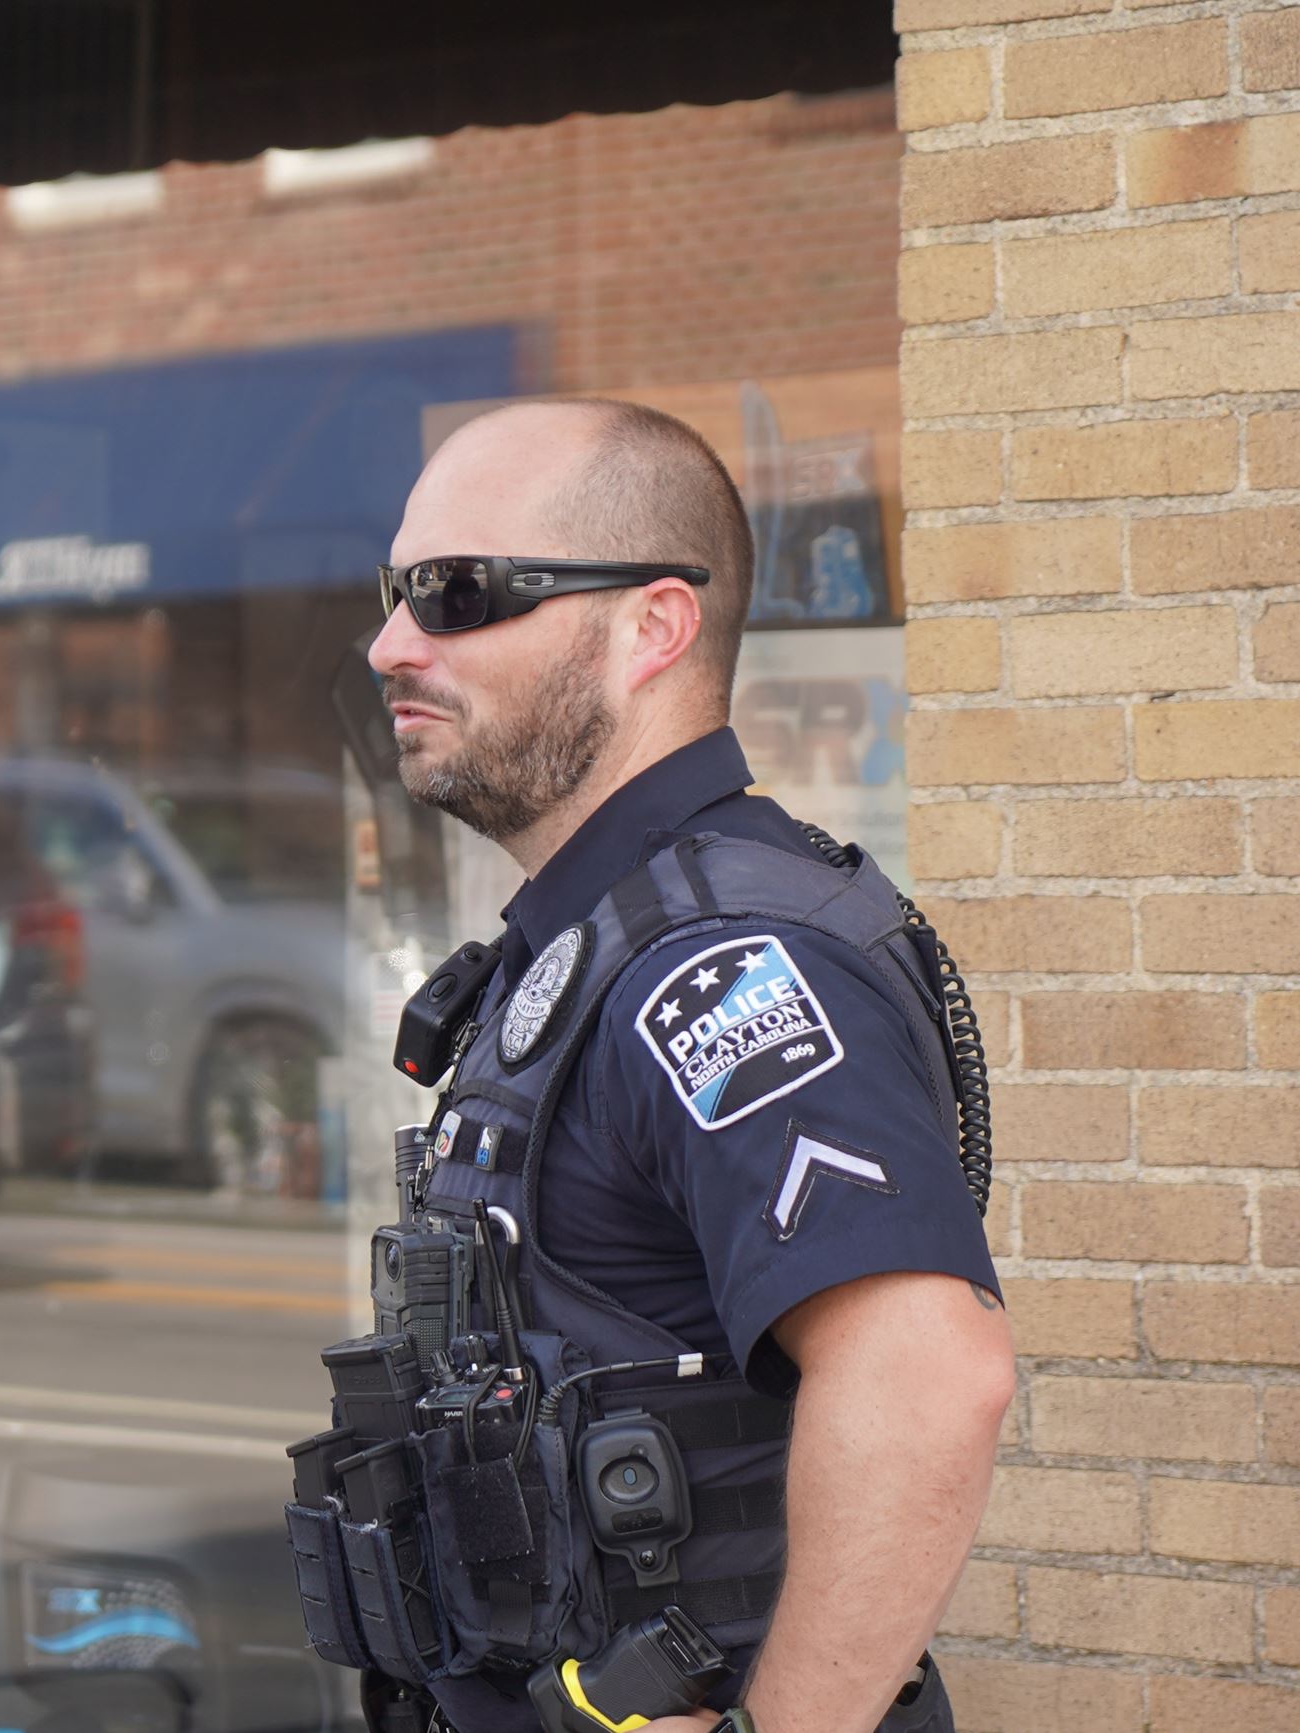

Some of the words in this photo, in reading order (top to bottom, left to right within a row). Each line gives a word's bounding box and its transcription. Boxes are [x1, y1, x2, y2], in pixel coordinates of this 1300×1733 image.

[667, 975, 796, 1065] POLICE
[684, 1001, 805, 1079] CLAYTON
[690, 1051, 737, 1091] NORTH
[737, 1017, 813, 1055] CAROLINA
[780, 1042, 817, 1063] 1869
